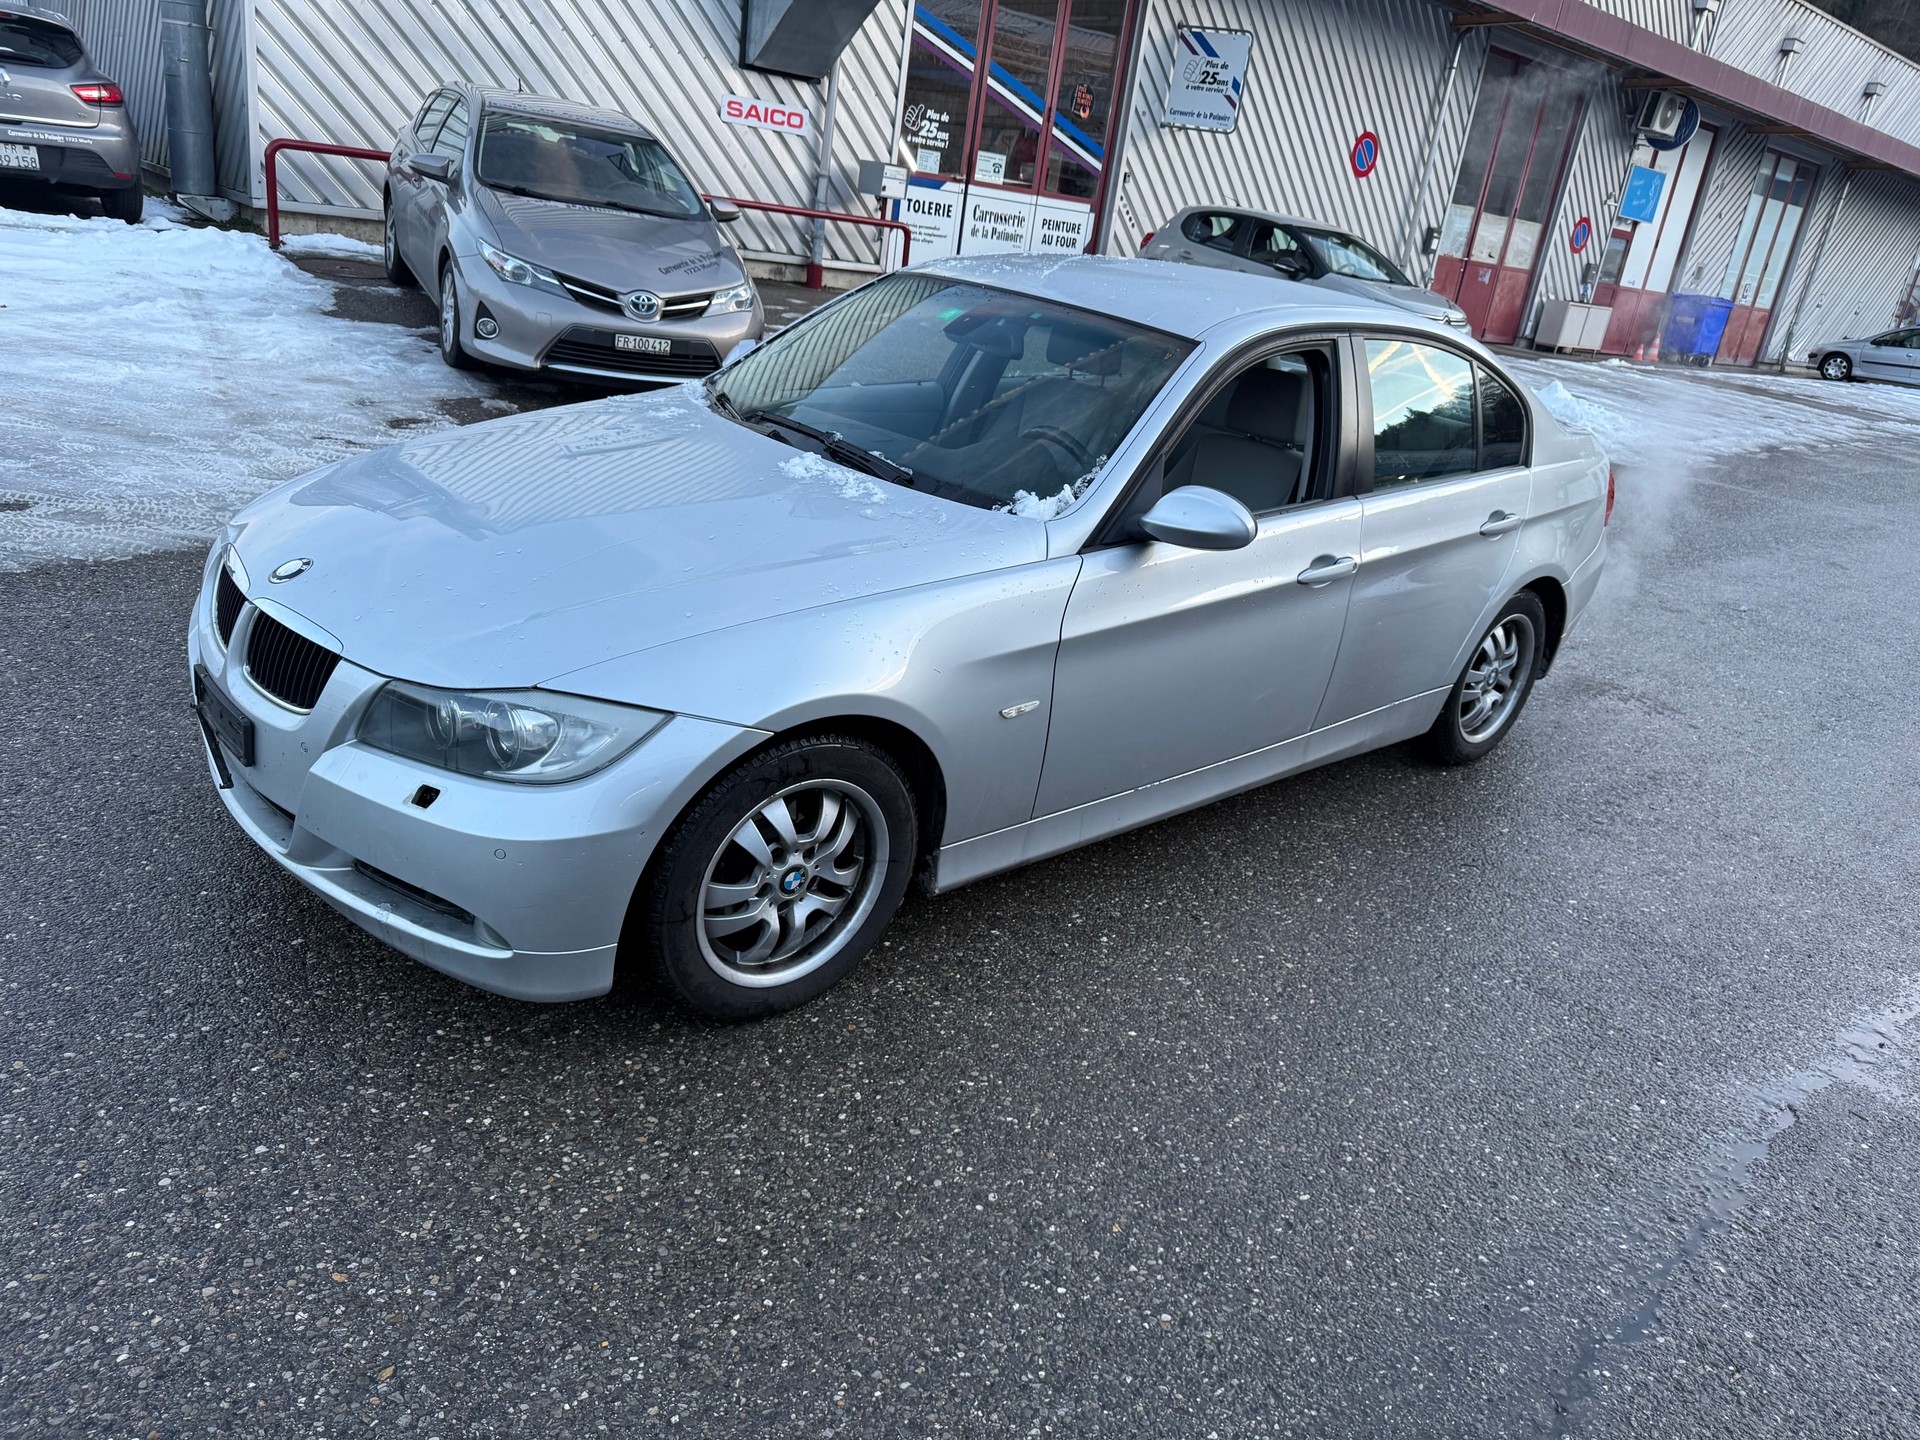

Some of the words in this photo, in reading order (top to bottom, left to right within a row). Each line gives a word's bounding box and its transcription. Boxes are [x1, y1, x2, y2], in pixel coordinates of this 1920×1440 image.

[1205, 60, 1218, 70] Plus
[1220, 62, 1229, 70] de
[727, 101, 804, 129] SAICO
[926, 109, 940, 120] Plus
[941, 112, 949, 123] de
[1170, 107, 1195, 118] Carrosserie
[1209, 112, 1230, 122] Patinoire
[4, 144, 17, 154] FR
[912, 136, 926, 145] votre
[927, 138, 944, 148] service
[16, 155, 37, 168] 158
[907, 198, 952, 218] TOLERIE
[973, 204, 1025, 228] Carrosserie
[1041, 218, 1081, 234] PEINTURE
[971, 225, 979, 238] de
[982, 225, 989, 239] la
[991, 226, 1024, 244] Patinoire
[1041, 234, 1053, 245] AU
[1055, 235, 1077, 249] FOUR
